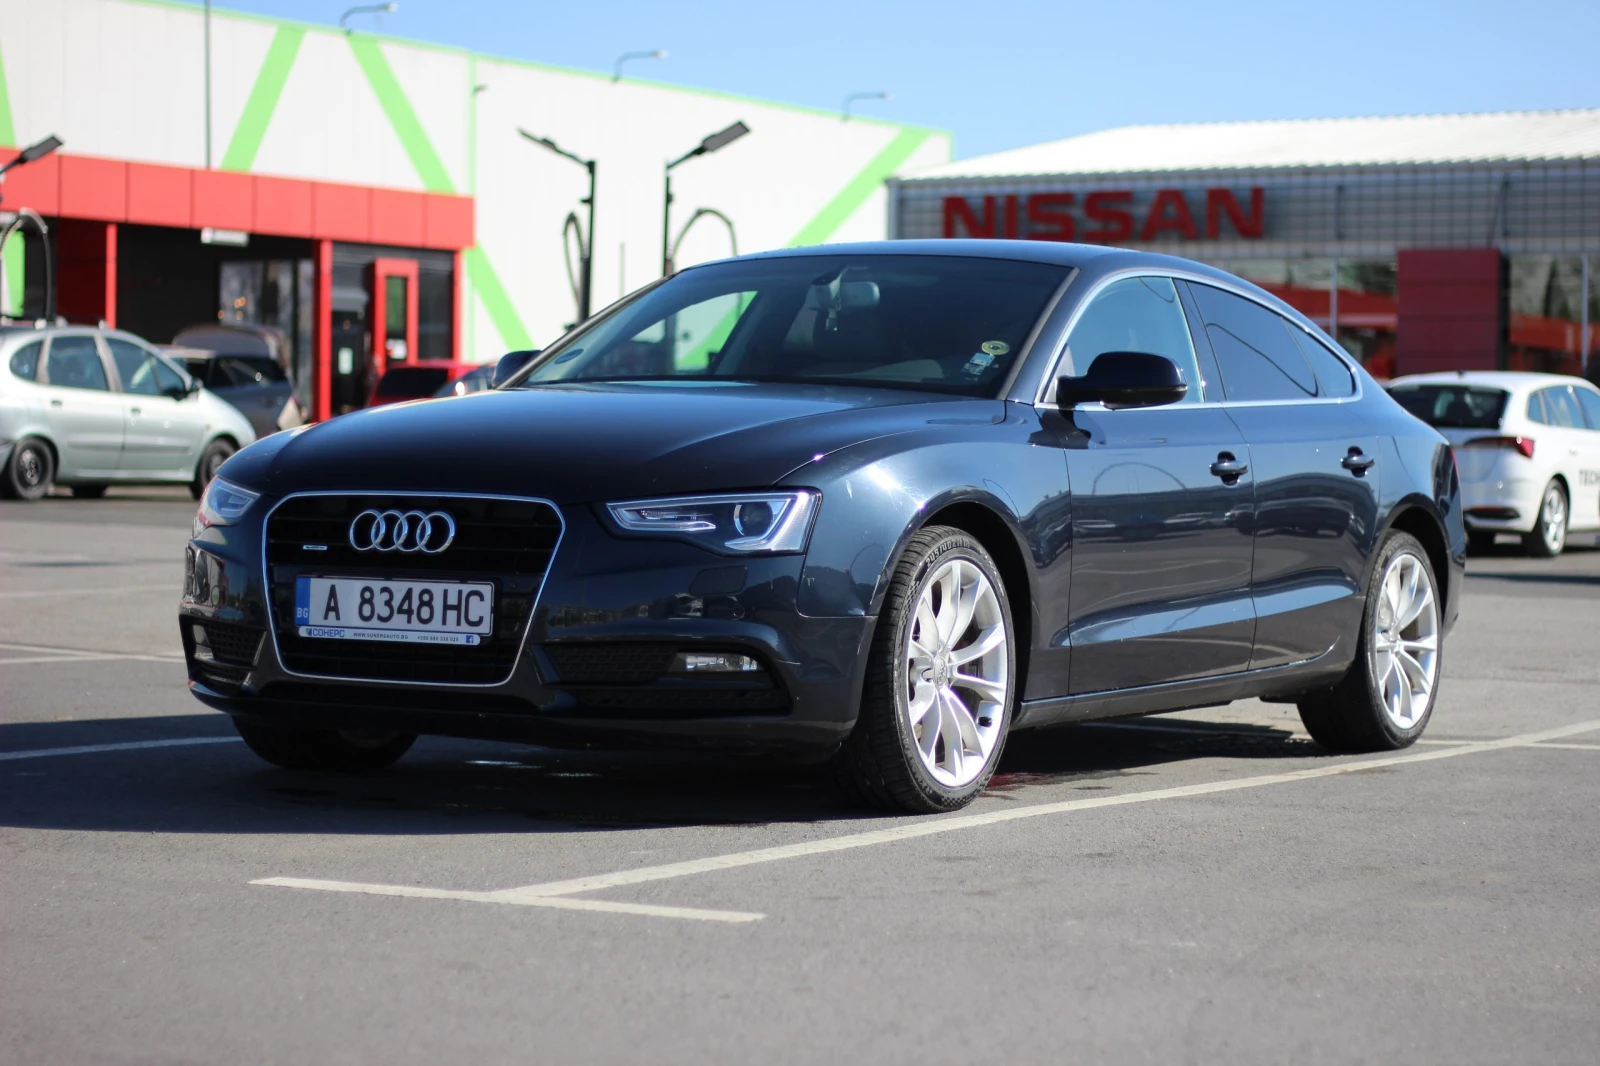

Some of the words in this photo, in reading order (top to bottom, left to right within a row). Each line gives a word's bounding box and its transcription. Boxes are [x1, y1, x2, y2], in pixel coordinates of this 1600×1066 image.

[942, 187, 1264, 241] NISSAN
[297, 607, 309, 618] BG
[323, 584, 341, 621] A
[358, 586, 434, 625] 8348
[442, 588, 485, 627] HC
